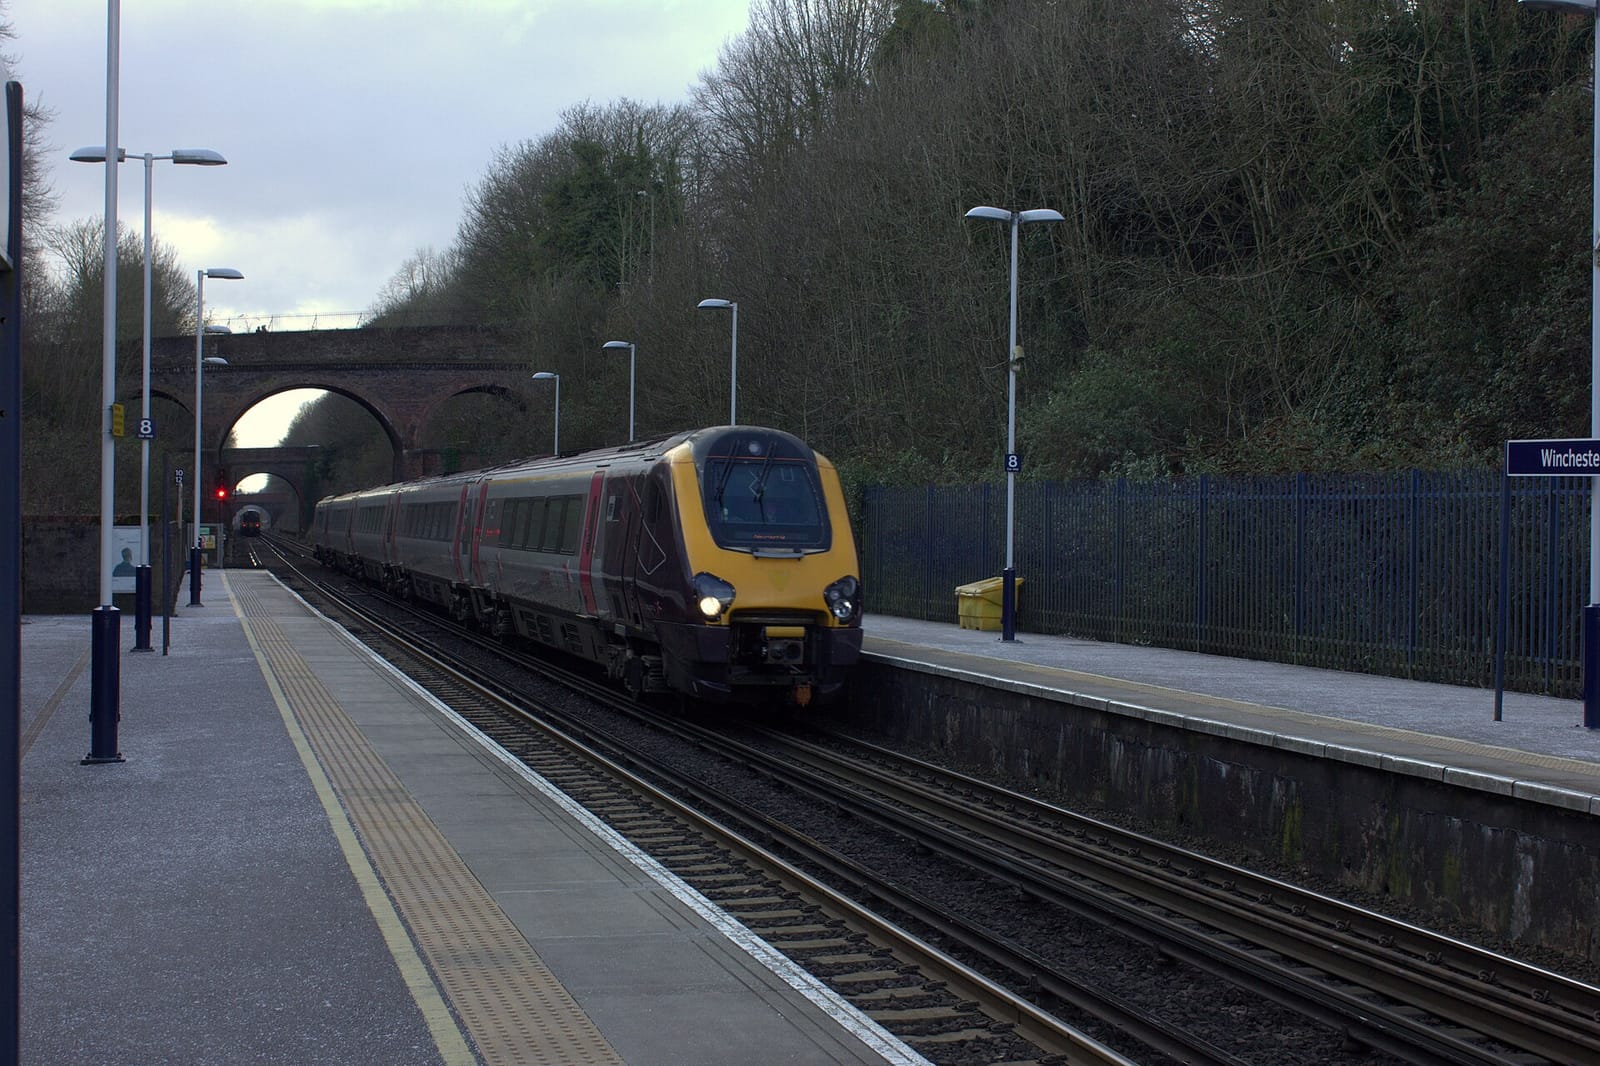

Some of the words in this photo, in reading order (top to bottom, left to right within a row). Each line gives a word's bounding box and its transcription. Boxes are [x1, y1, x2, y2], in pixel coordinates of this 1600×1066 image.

[140, 419, 152, 434] 8
[1008, 455, 1018, 468] 8
[1541, 448, 1600, 468] Wincheste
